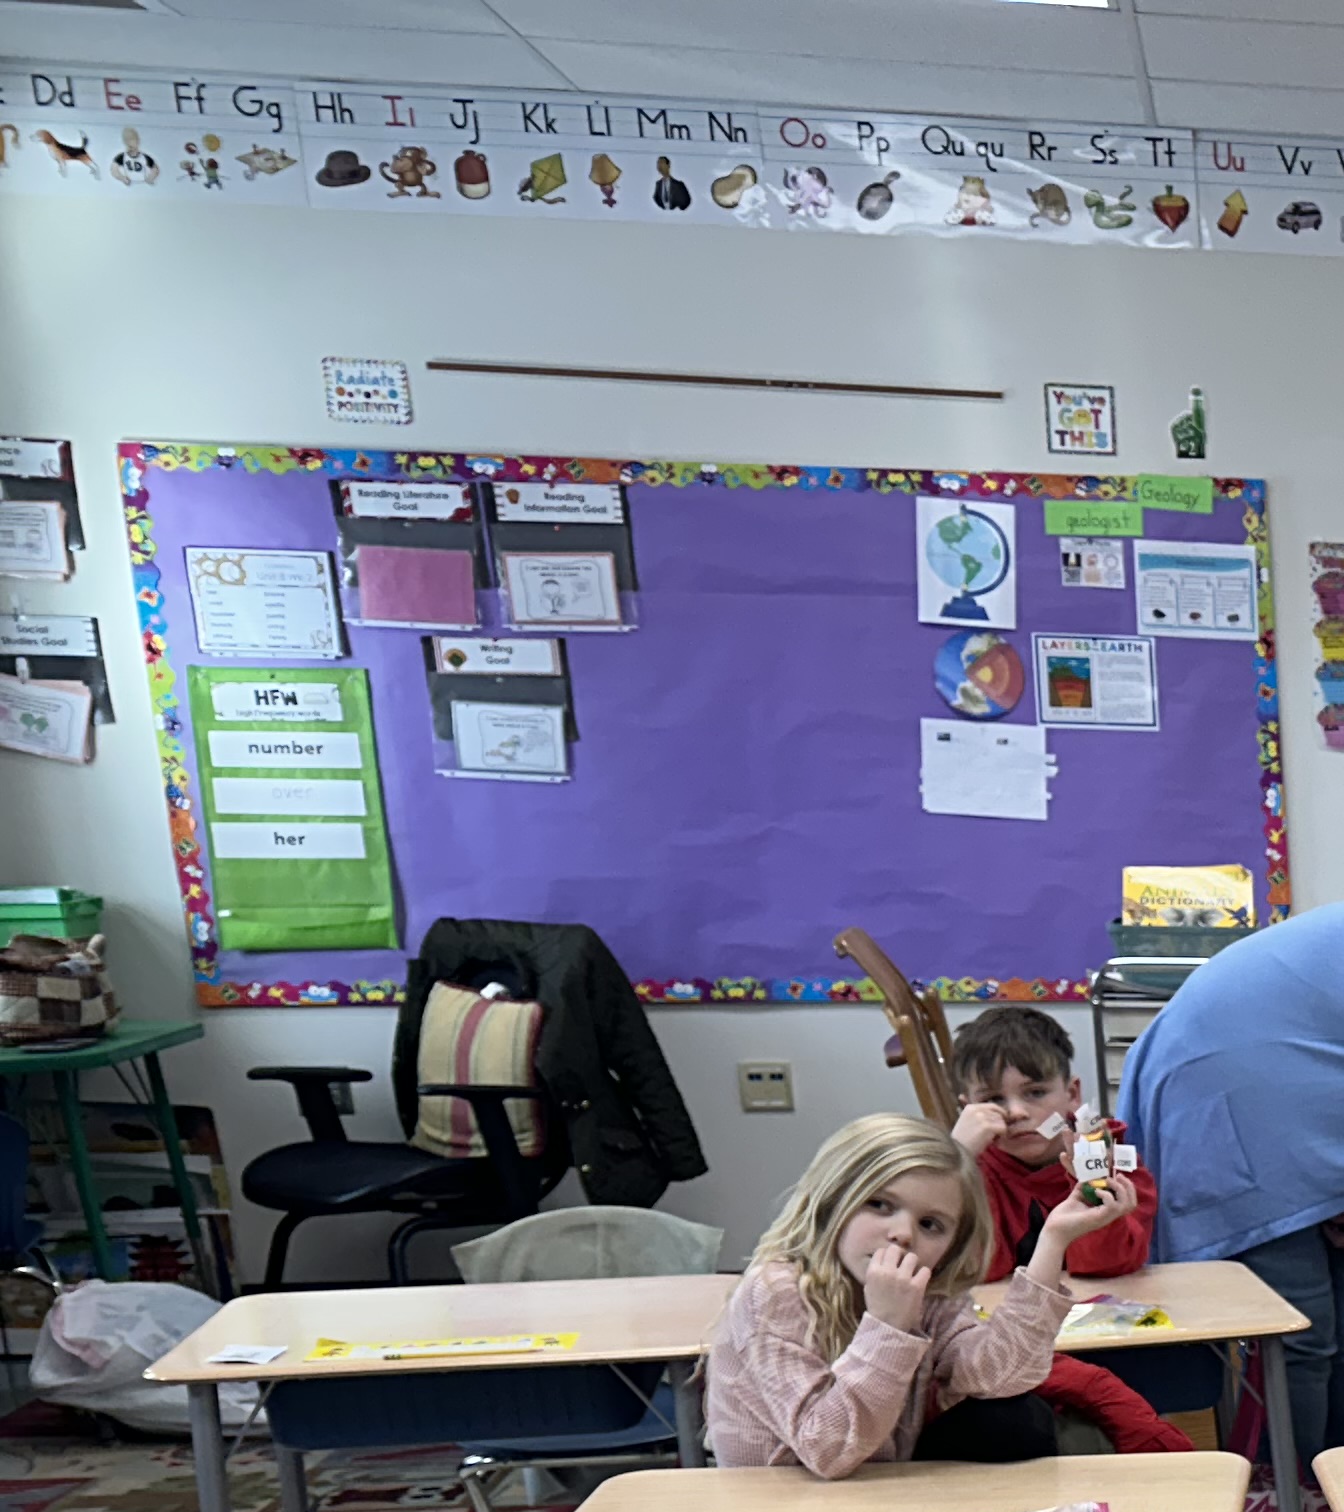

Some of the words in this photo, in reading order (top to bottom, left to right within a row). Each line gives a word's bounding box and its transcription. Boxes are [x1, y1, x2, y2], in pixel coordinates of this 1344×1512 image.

[32, 74, 74, 108] Dd
[104, 79, 141, 112] Ee
[174, 80, 205, 115] Ff
[232, 85, 283, 132] Gg
[313, 91, 354, 125] Hh
[382, 95, 416, 128] Ii
[449, 98, 480, 144] Jj
[522, 102, 558, 135] Kk
[588, 103, 612, 137] Ll
[638, 108, 691, 142] Mm
[709, 111, 748, 144] Nn
[781, 117, 826, 149] Oo
[857, 122, 890, 165] Pp
[921, 125, 966, 158] Qu
[976, 139, 1004, 172] qu
[1029, 131, 1058, 162] Rr
[1090, 135, 1119, 166] Ss
[1146, 137, 1176, 168] Tt
[1212, 142, 1246, 173] Uu
[1277, 145, 1313, 176] Vv
[336, 370, 395, 386] Radiate
[1053, 390, 1106, 407] You've
[338, 401, 399, 414] POSITIVITY
[1058, 407, 1102, 430] GOT
[1055, 430, 1108, 448] THIS
[1140, 480, 1200, 509] Geology
[1066, 510, 1131, 534] geologist
[16, 625, 49, 634] Social
[1041, 640, 1091, 652] LAYERS
[1100, 641, 1143, 653] EARTH
[254, 689, 298, 706] HFW
[248, 741, 324, 755] number
[274, 832, 305, 845] her
